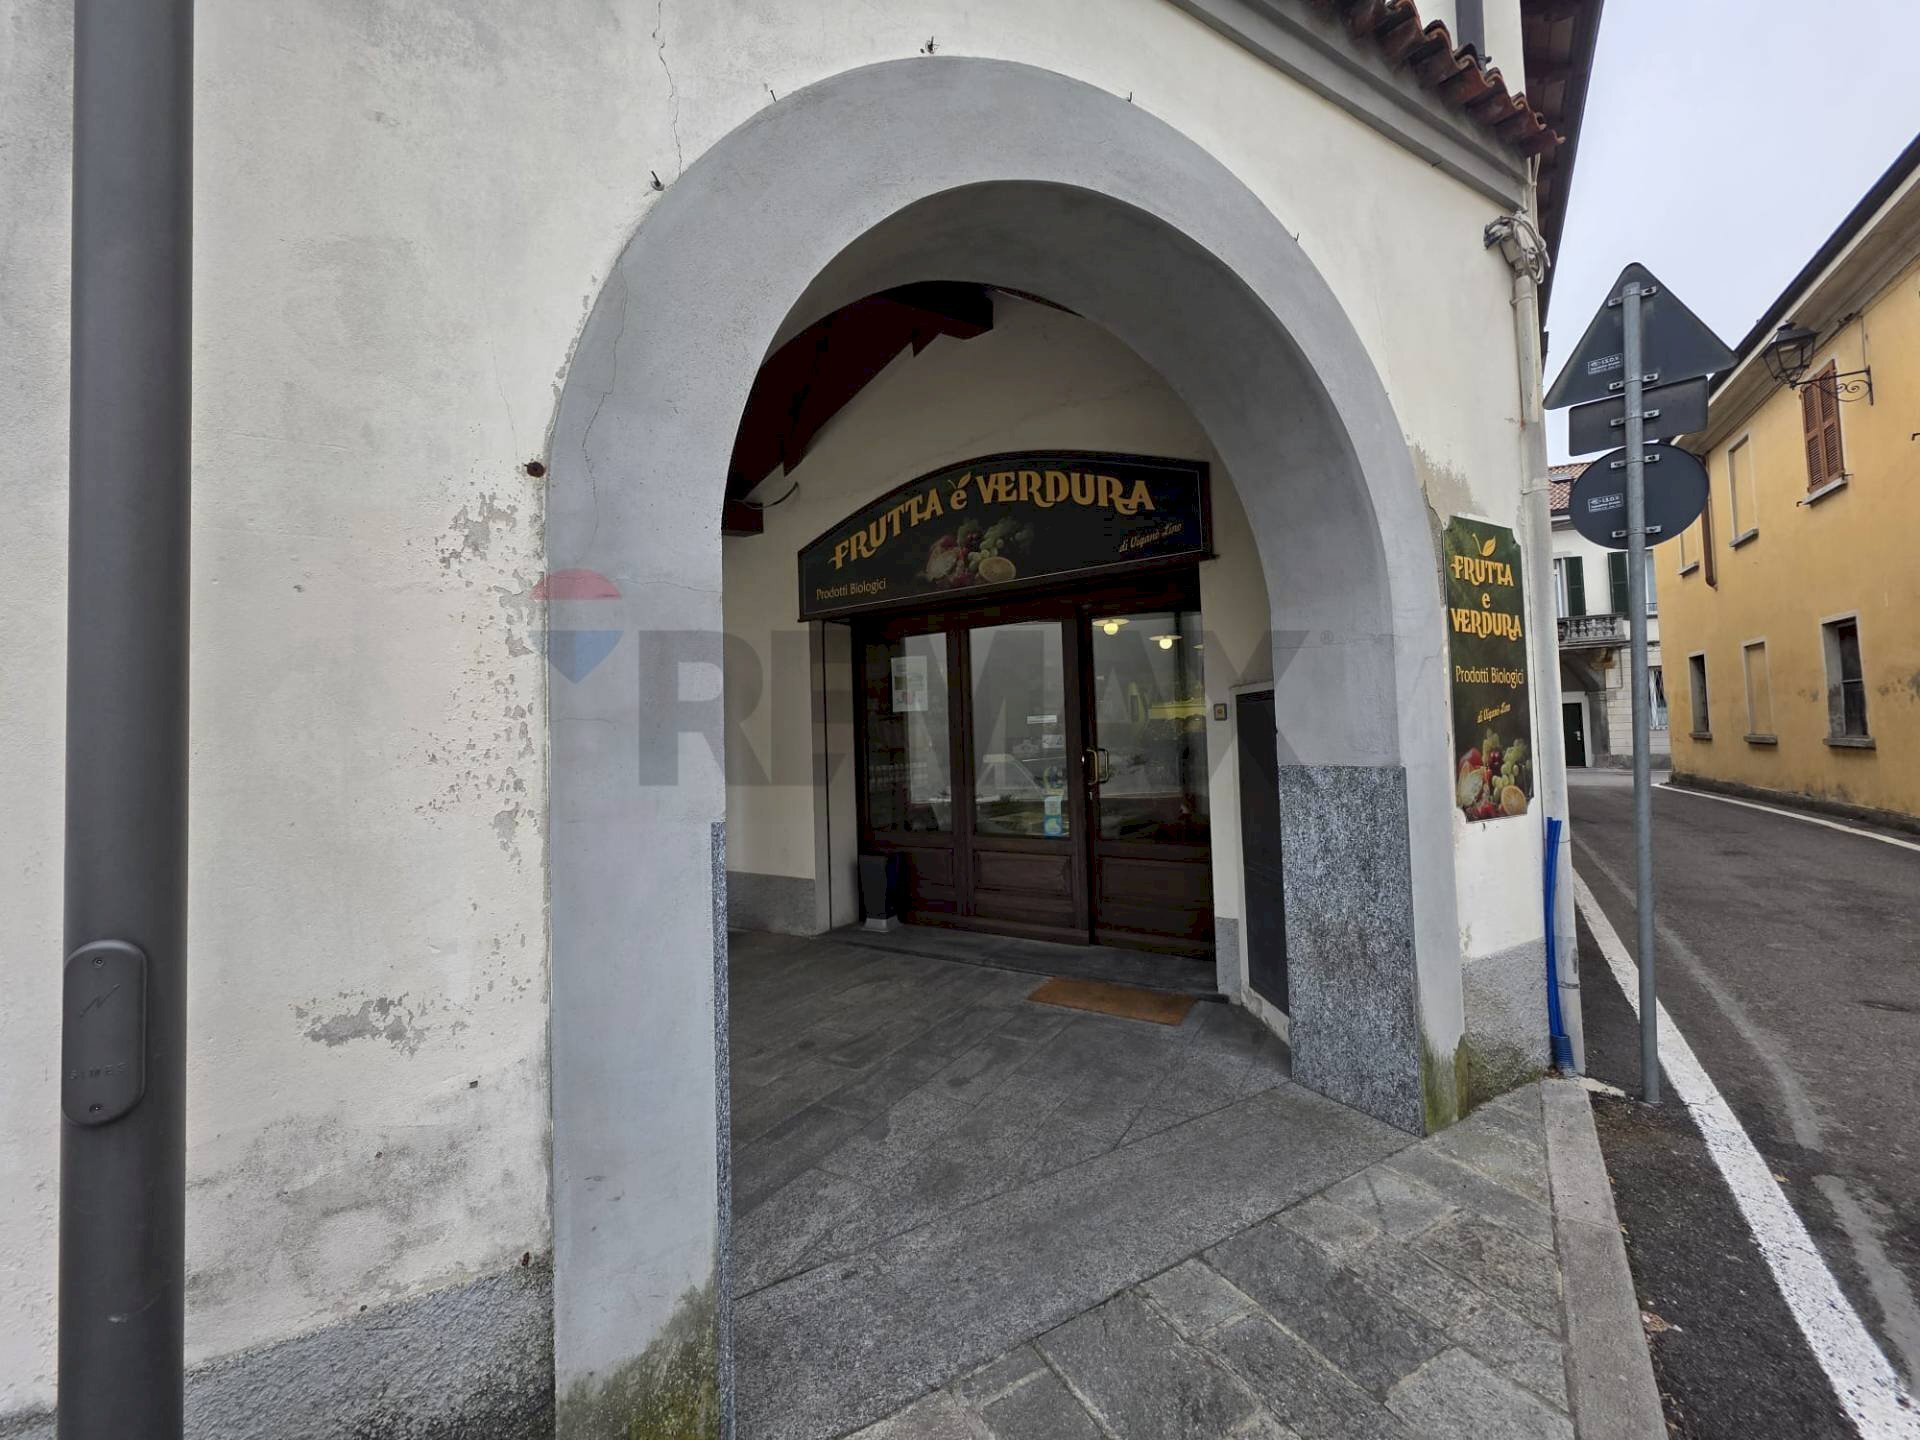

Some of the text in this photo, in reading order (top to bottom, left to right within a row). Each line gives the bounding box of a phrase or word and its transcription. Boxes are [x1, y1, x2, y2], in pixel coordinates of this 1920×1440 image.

[829, 488, 944, 570] FRUTTA
[975, 470, 1155, 515] VERDURA
[1450, 555, 1514, 587] FRUTTA
[816, 577, 886, 601] Prodotti Biologici
[1481, 592, 1491, 608] e
[1451, 608, 1522, 641] VERDURA
[1455, 666, 1524, 689] Prodotti Biologici
